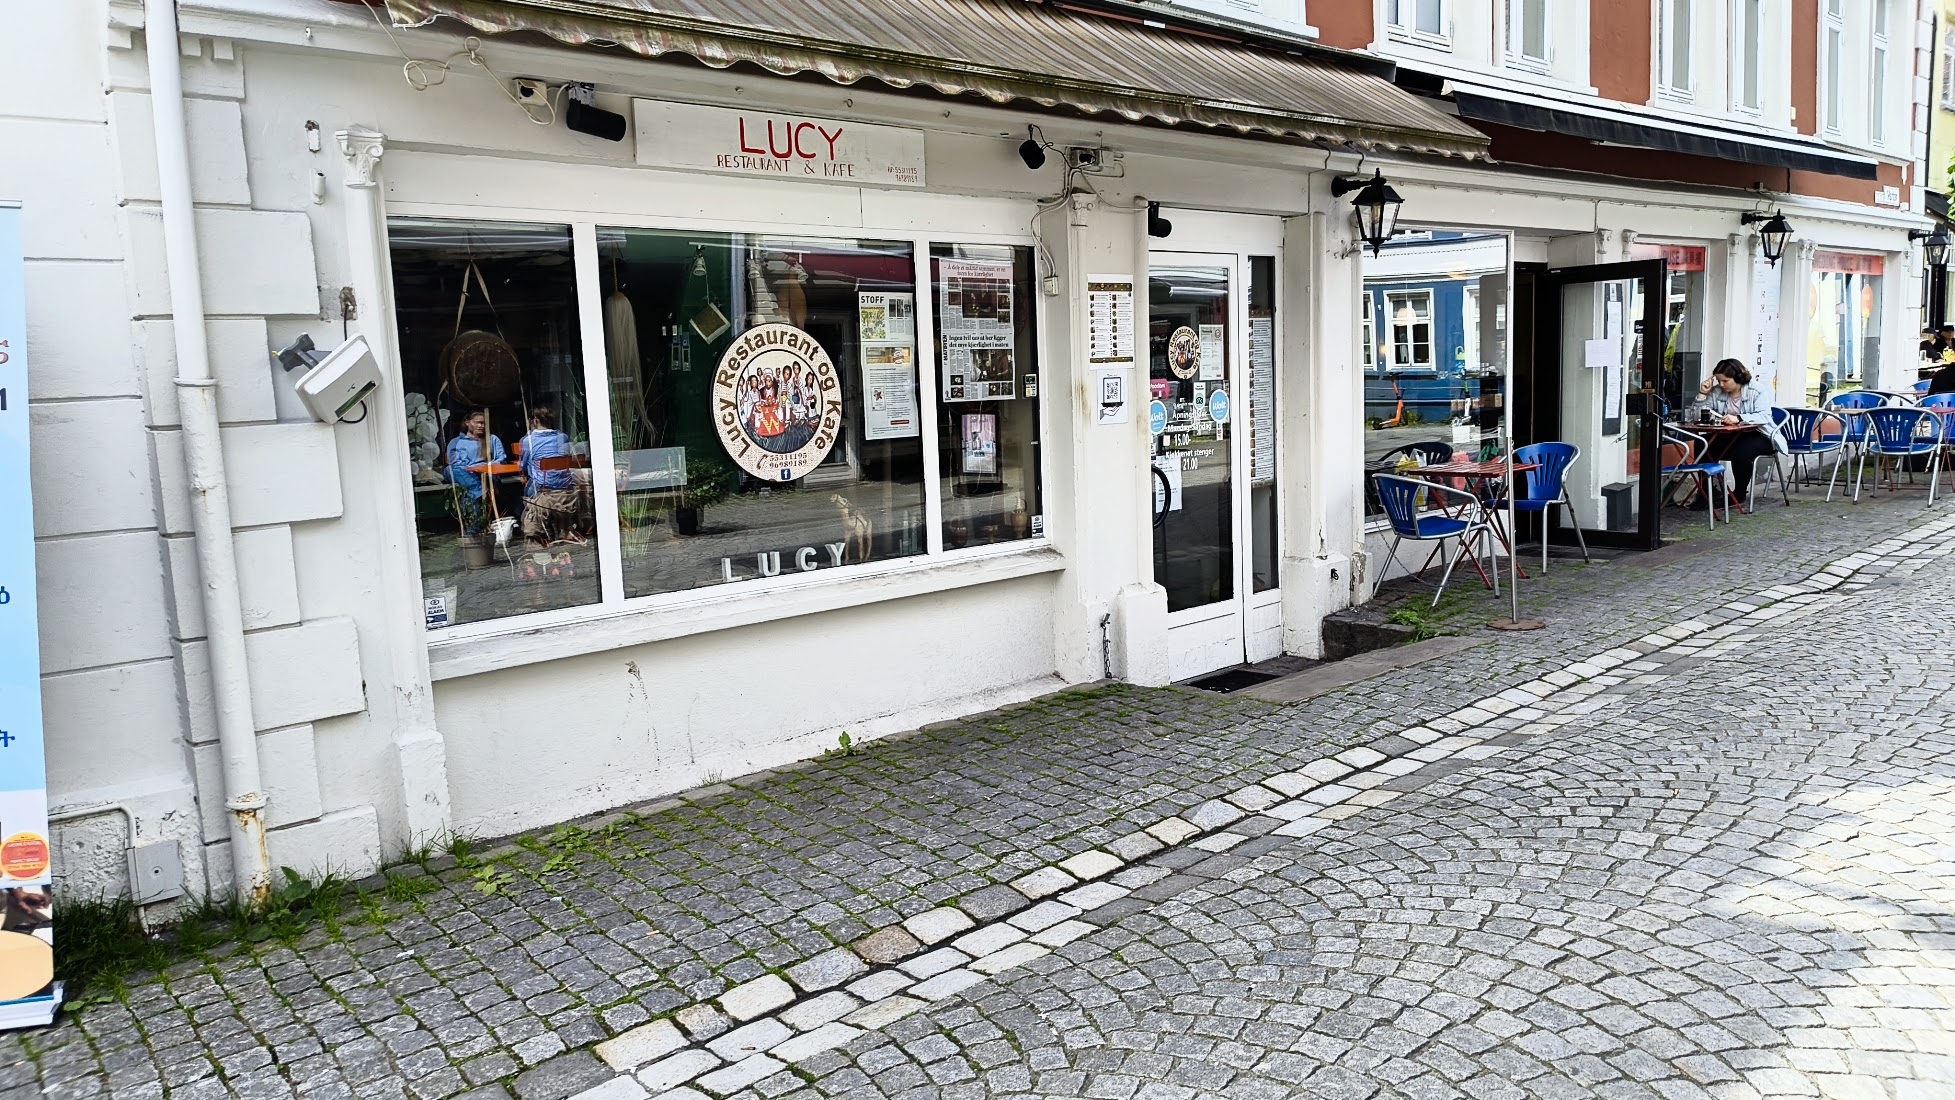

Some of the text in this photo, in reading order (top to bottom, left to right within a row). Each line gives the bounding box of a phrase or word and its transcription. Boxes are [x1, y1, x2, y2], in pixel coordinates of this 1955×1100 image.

[739, 117, 843, 161] LUCY
[717, 154, 855, 177] RESTAURANT & KAFE
[861, 296, 885, 304] STOFF
[716, 329, 820, 390] Restaurant
[817, 362, 836, 392] og
[1212, 401, 1227, 411] Wolt
[718, 397, 751, 459] Lucy
[814, 399, 842, 450] Kafe
[769, 452, 808, 461] 55311195
[1183, 457, 1199, 471] 21.00
[1194, 448, 1214, 458] stenger
[721, 542, 846, 583] LUCY
